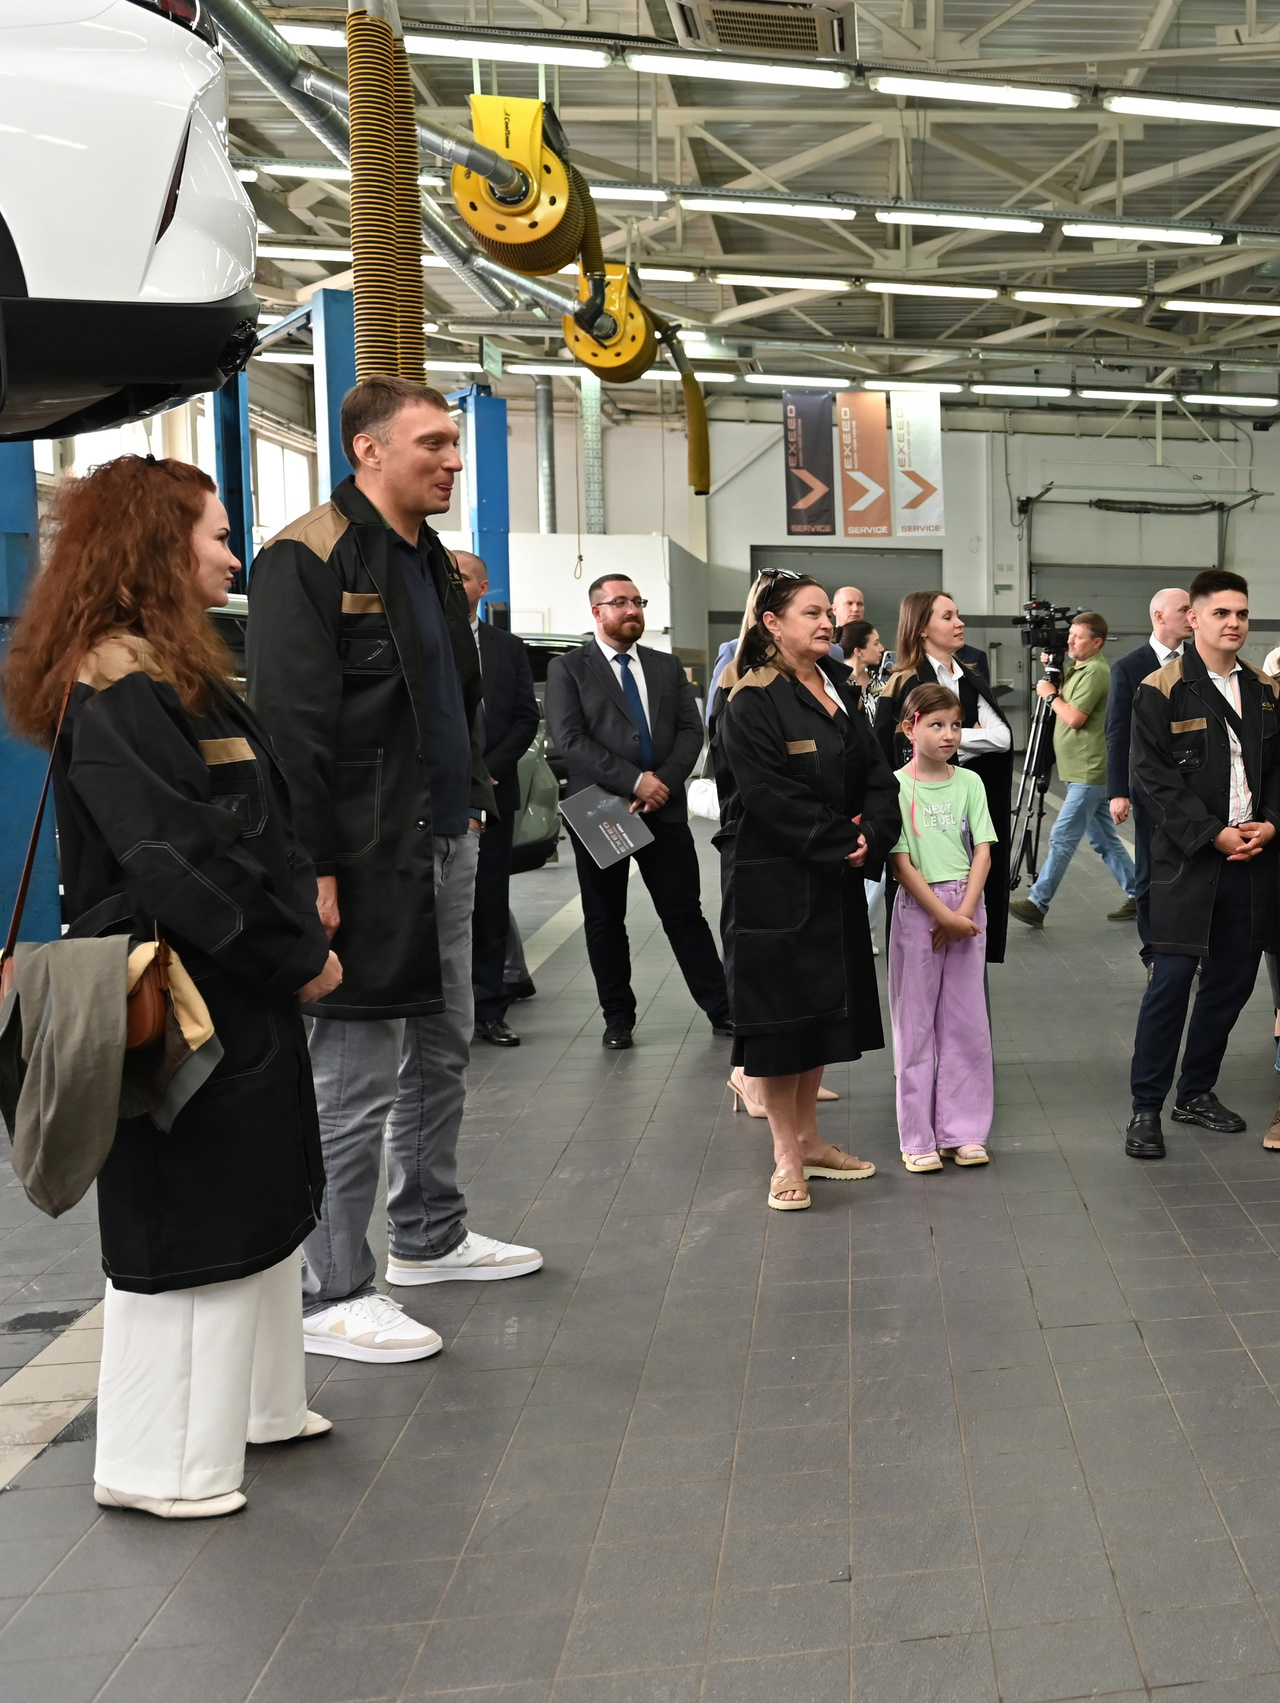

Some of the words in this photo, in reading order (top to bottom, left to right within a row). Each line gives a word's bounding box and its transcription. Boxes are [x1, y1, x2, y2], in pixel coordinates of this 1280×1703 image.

[786, 404, 797, 467] EXEED
[841, 407, 853, 469] EXEED
[896, 407, 907, 468] EXEED
[791, 524, 832, 533] SERVICE
[848, 525, 889, 534] SERVICE
[901, 524, 942, 533] SERVICE
[922, 803, 953, 816] NEXT
[923, 814, 957, 828] LEVEL
